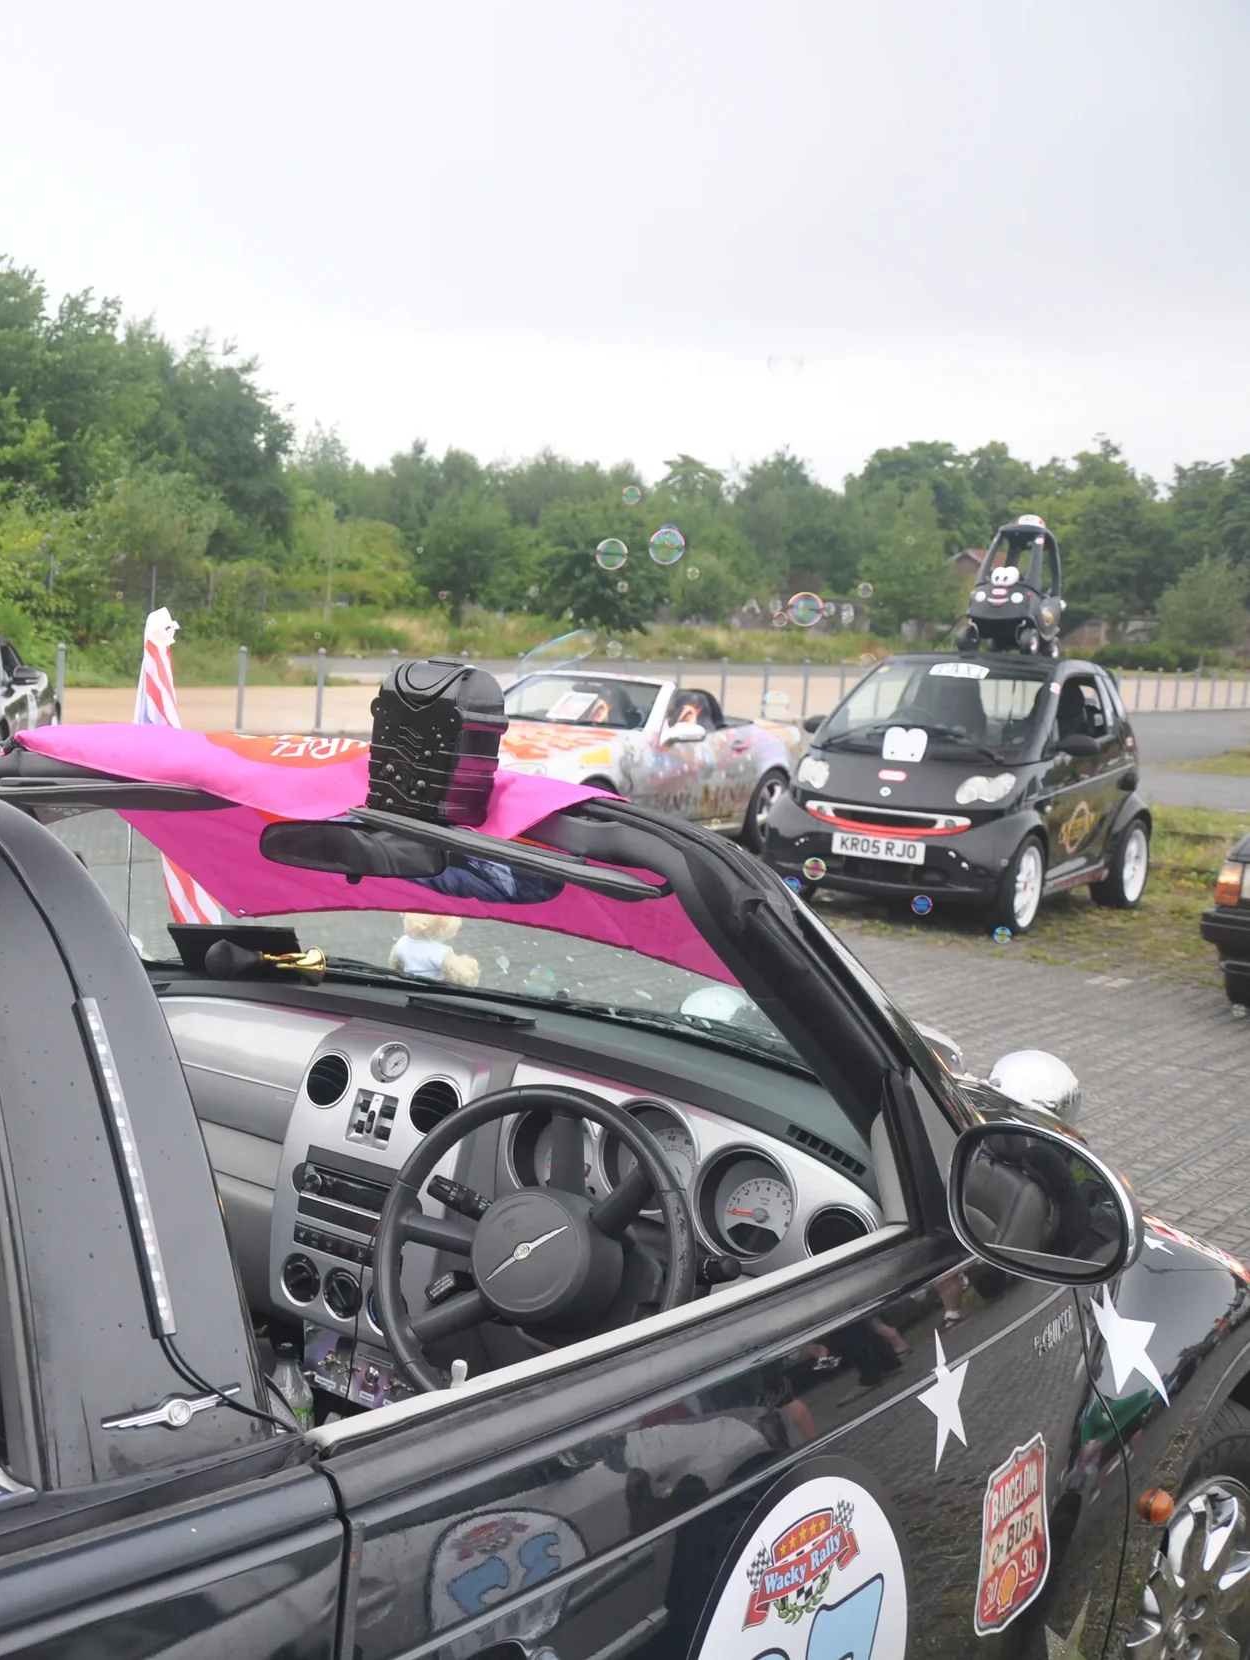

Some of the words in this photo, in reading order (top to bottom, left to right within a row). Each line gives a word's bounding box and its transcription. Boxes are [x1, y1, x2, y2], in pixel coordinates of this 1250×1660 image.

[840, 836, 880, 854] KR05
[991, 1460, 1039, 1531] BARCELONA
[764, 1562, 808, 1595] Wacky
[810, 1531, 842, 1572] Rally
[1007, 1511, 1035, 1551] BUST
[983, 1576, 998, 1611] 30
[1021, 1546, 1038, 1578] 30
